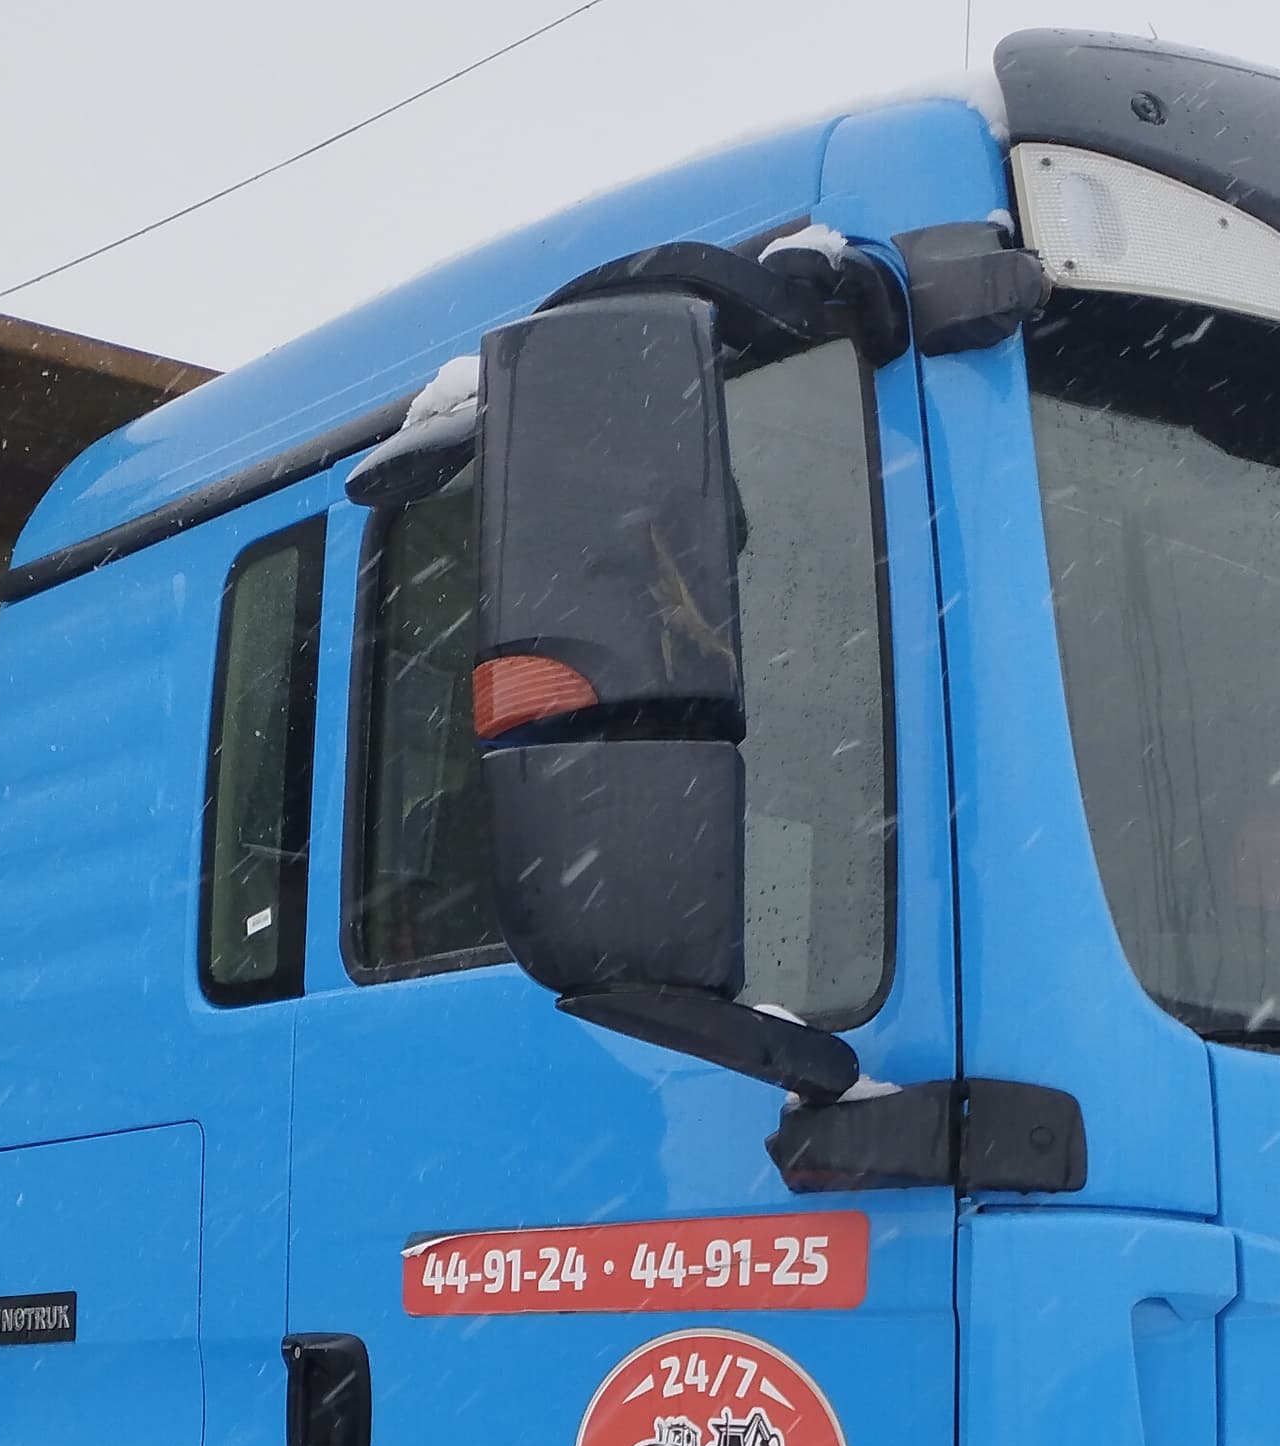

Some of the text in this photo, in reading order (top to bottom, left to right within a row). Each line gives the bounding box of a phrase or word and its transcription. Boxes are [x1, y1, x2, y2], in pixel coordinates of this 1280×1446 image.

[421, 1236, 829, 1295] 44-91-24 44-91-25
[660, 1353, 759, 1399] 24/7
